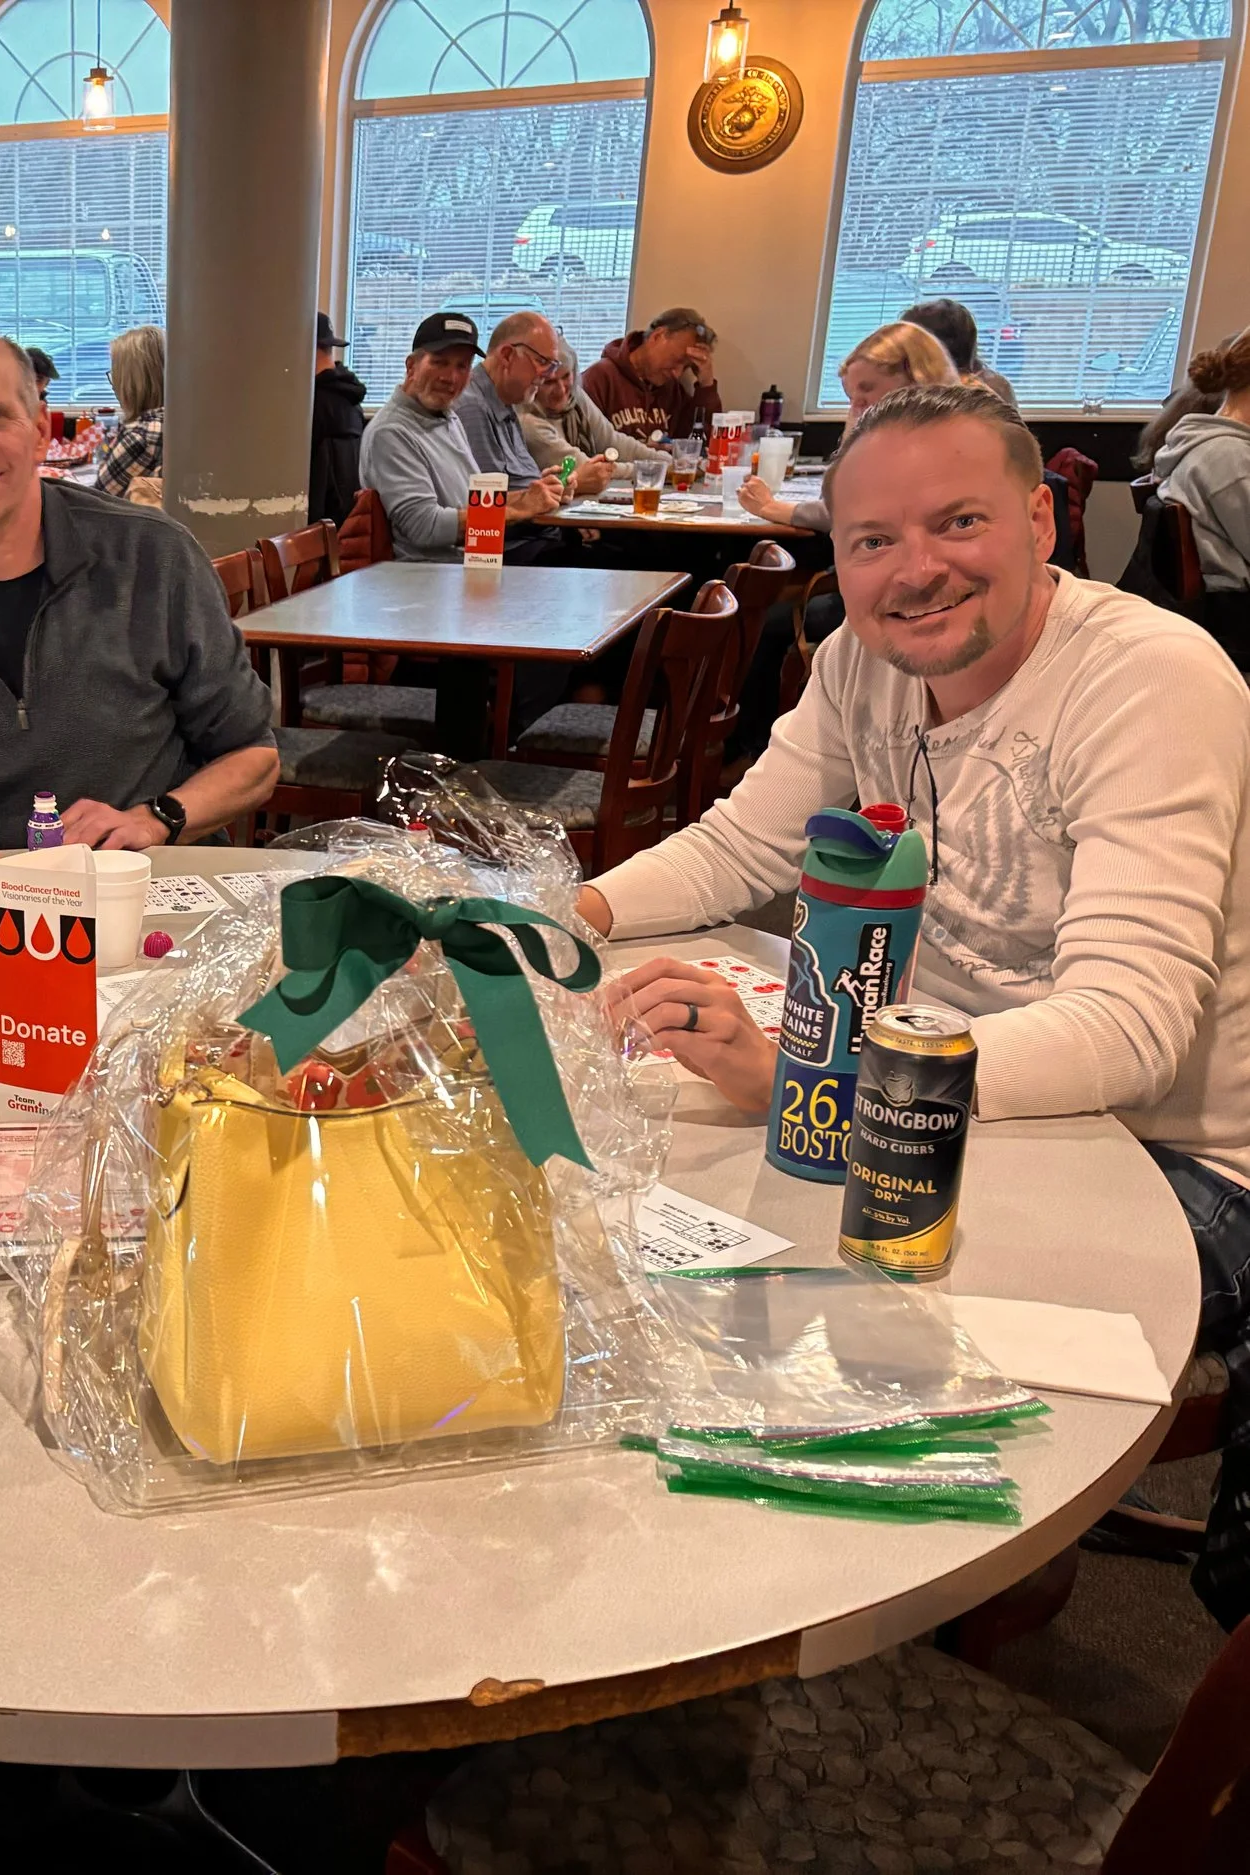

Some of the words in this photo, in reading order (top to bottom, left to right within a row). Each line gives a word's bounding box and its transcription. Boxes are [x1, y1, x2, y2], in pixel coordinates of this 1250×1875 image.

[468, 527, 501, 538] Donate
[1, 881, 24, 892] Blood
[24, 884, 53, 895] Cancer
[53, 887, 81, 898] United
[1, 890, 42, 904] Visionaries
[42, 895, 51, 904] of
[51, 896, 66, 906] the
[66, 898, 84, 907] Year
[859, 927, 888, 976] Race
[784, 994, 825, 1023] WHITE
[0, 1014, 88, 1047] Donate
[14, 1094, 36, 1105] Team
[855, 1092, 960, 1132] STRONGBOW
[859, 1128, 888, 1150] HARD
[890, 1142, 936, 1155] CIDERS
[852, 1160, 938, 1195] ORIGINAL
[874, 1188, 903, 1204] DRY
[886, 1214, 896, 1223] by
[897, 1215, 912, 1225] Vol.
